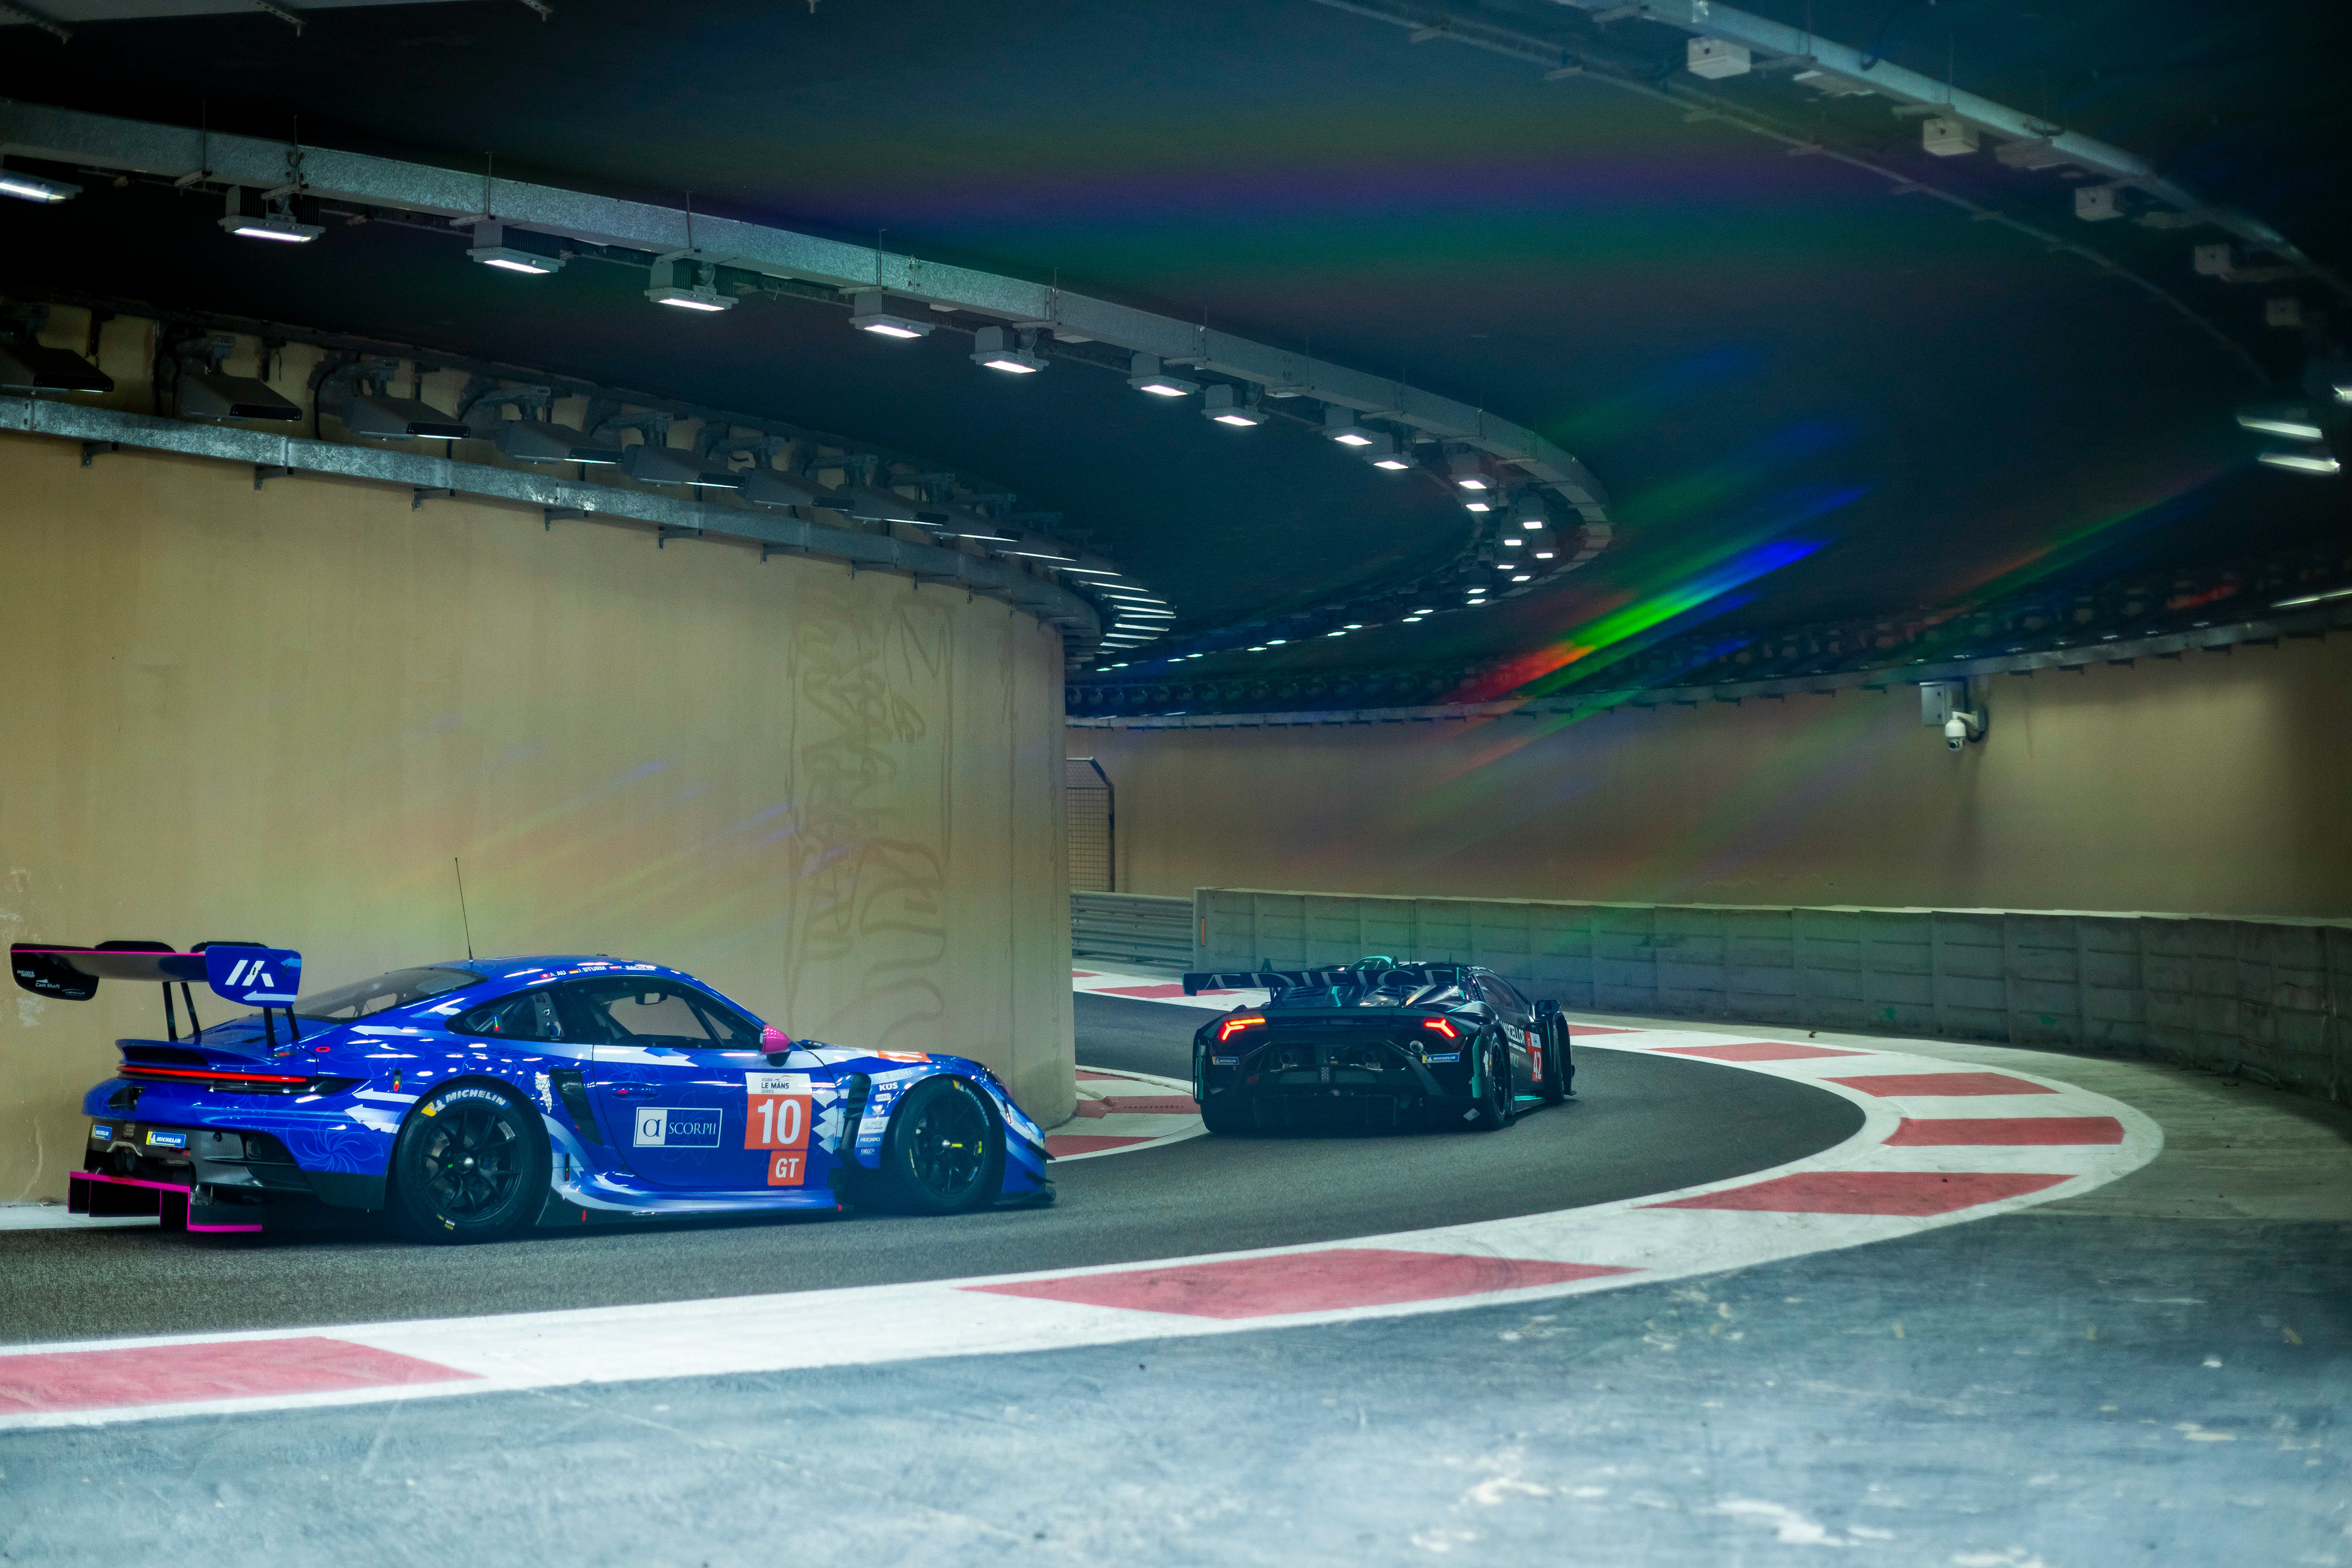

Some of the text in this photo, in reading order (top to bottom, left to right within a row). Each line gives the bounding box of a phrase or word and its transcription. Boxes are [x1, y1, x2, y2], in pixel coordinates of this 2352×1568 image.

[1533, 1051, 1542, 1079] 42
[445, 1089, 507, 1106] MICHELIN
[668, 1122, 717, 1135] SCORPII
[758, 1099, 801, 1144] 10
[775, 1158, 799, 1178] GT
